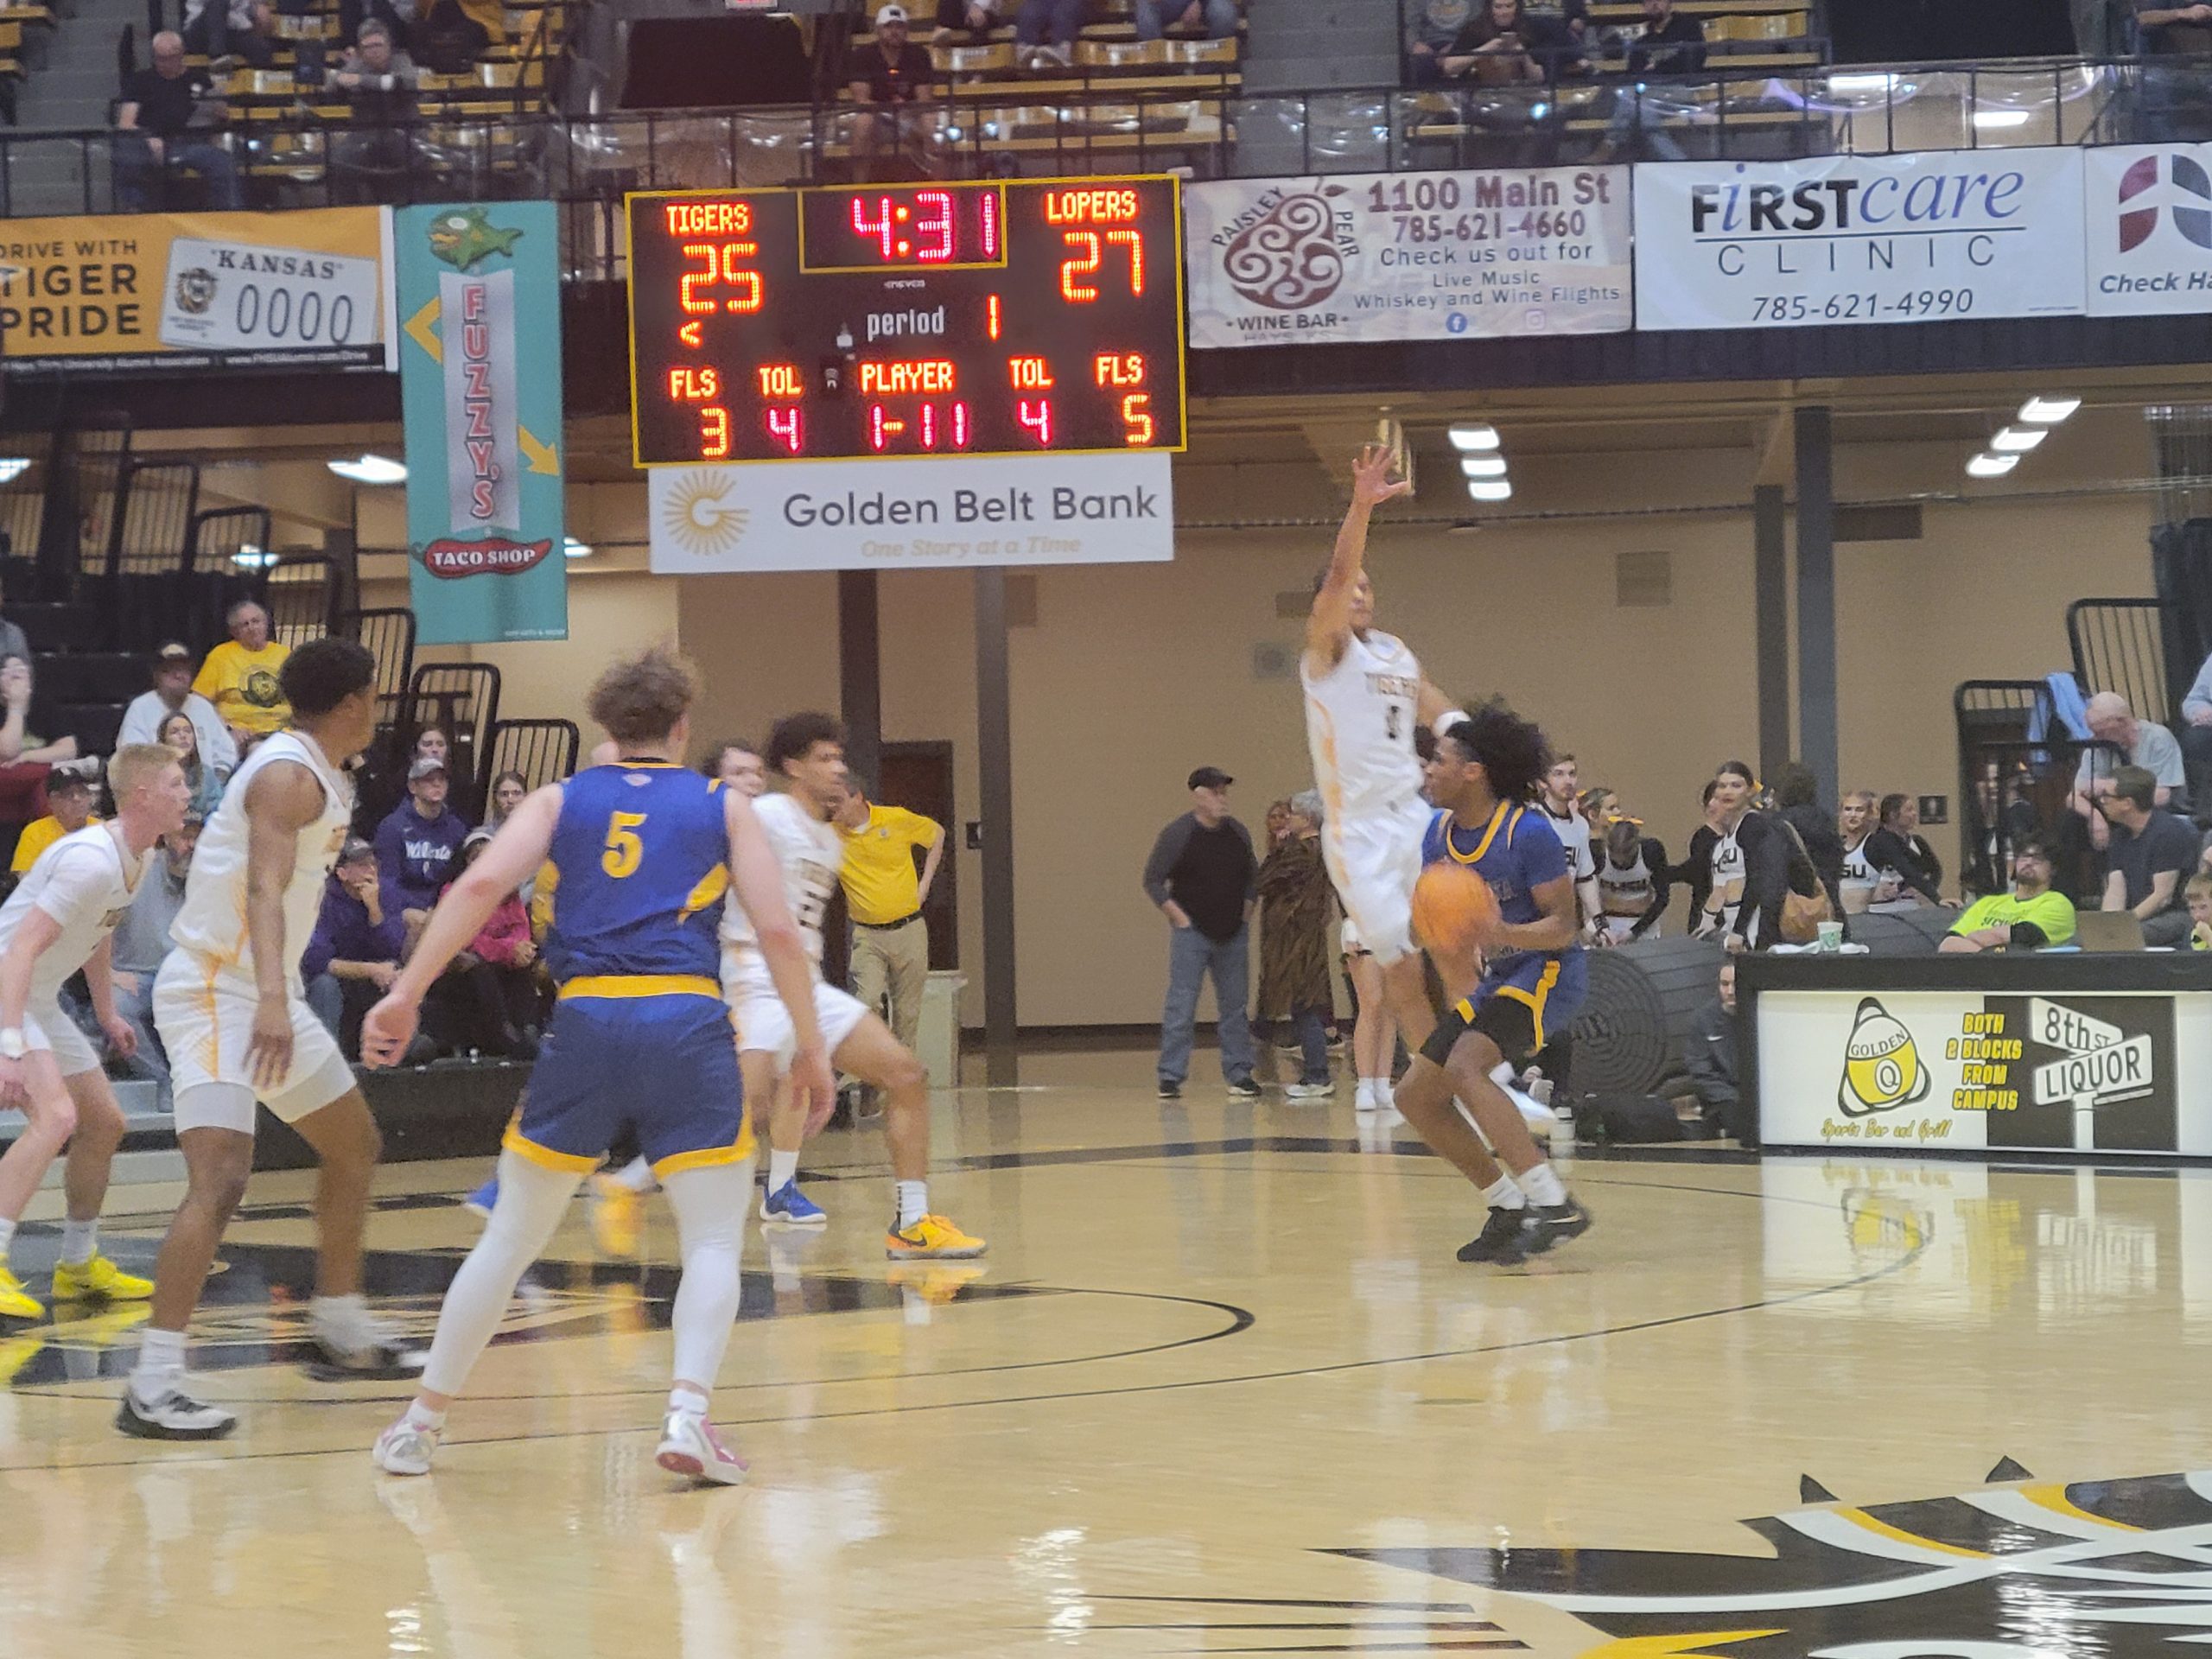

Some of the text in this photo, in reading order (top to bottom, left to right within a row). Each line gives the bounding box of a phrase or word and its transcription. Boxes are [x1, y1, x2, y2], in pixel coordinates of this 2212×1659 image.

[1046, 190, 1139, 223] LOPERS
[1368, 173, 1610, 213] 1100 Main St
[665, 203, 751, 236] TIGERS
[852, 191, 995, 259] 4:31
[1211, 186, 1286, 246] PAISLEY
[1393, 210, 1586, 243] 785-621-4660
[74, 240, 137, 256] WITH
[1335, 212, 1360, 257] PEAR
[218, 250, 335, 280] KANSAS
[1062, 230, 1143, 303] 27
[1381, 242, 1592, 266] Check us out for
[1718, 235, 1993, 276] CLINIC
[0, 264, 137, 297] TIGER
[678, 242, 765, 315] 25
[1433, 271, 1540, 288] Live Music
[2100, 272, 2180, 293] Check
[1354, 287, 1620, 309] Whiskey and Wine Flights
[1752, 289, 1974, 321] 785-621-4990
[0, 304, 141, 337] PRIDE
[868, 305, 944, 342] period
[1237, 313, 1337, 331] WINE BAR
[669, 365, 719, 401] FLS
[758, 365, 804, 397] TOL
[860, 359, 957, 394] PLAYER
[1009, 355, 1054, 389] TOL
[1096, 353, 1147, 386] FLS
[462, 283, 499, 518] FUZZY'S
[701, 406, 730, 458] 3
[767, 406, 801, 451] 4
[1019, 398, 1052, 445] 4
[1123, 392, 1154, 445] 5
[784, 486, 1158, 527] Golden Belt Bank
[434, 548, 536, 565] TACO SHOP
[862, 537, 1082, 558] One Story at a Time
[601, 810, 648, 879] 5
[1962, 1013, 2005, 1034] BOTH
[2045, 1007, 2110, 1050] 8th ST
[1851, 1030, 1906, 1057] GOLDEN
[1946, 1038, 2024, 1059] 2 BLOCKS
[1879, 1065, 1898, 1087] Q
[1962, 1064, 2007, 1085] FROM
[2045, 1046, 2141, 1098] LIQUOR
[1953, 1090, 2018, 1110] CAMPUS
[1821, 1118, 1953, 1143] Sports Bar and Grill
